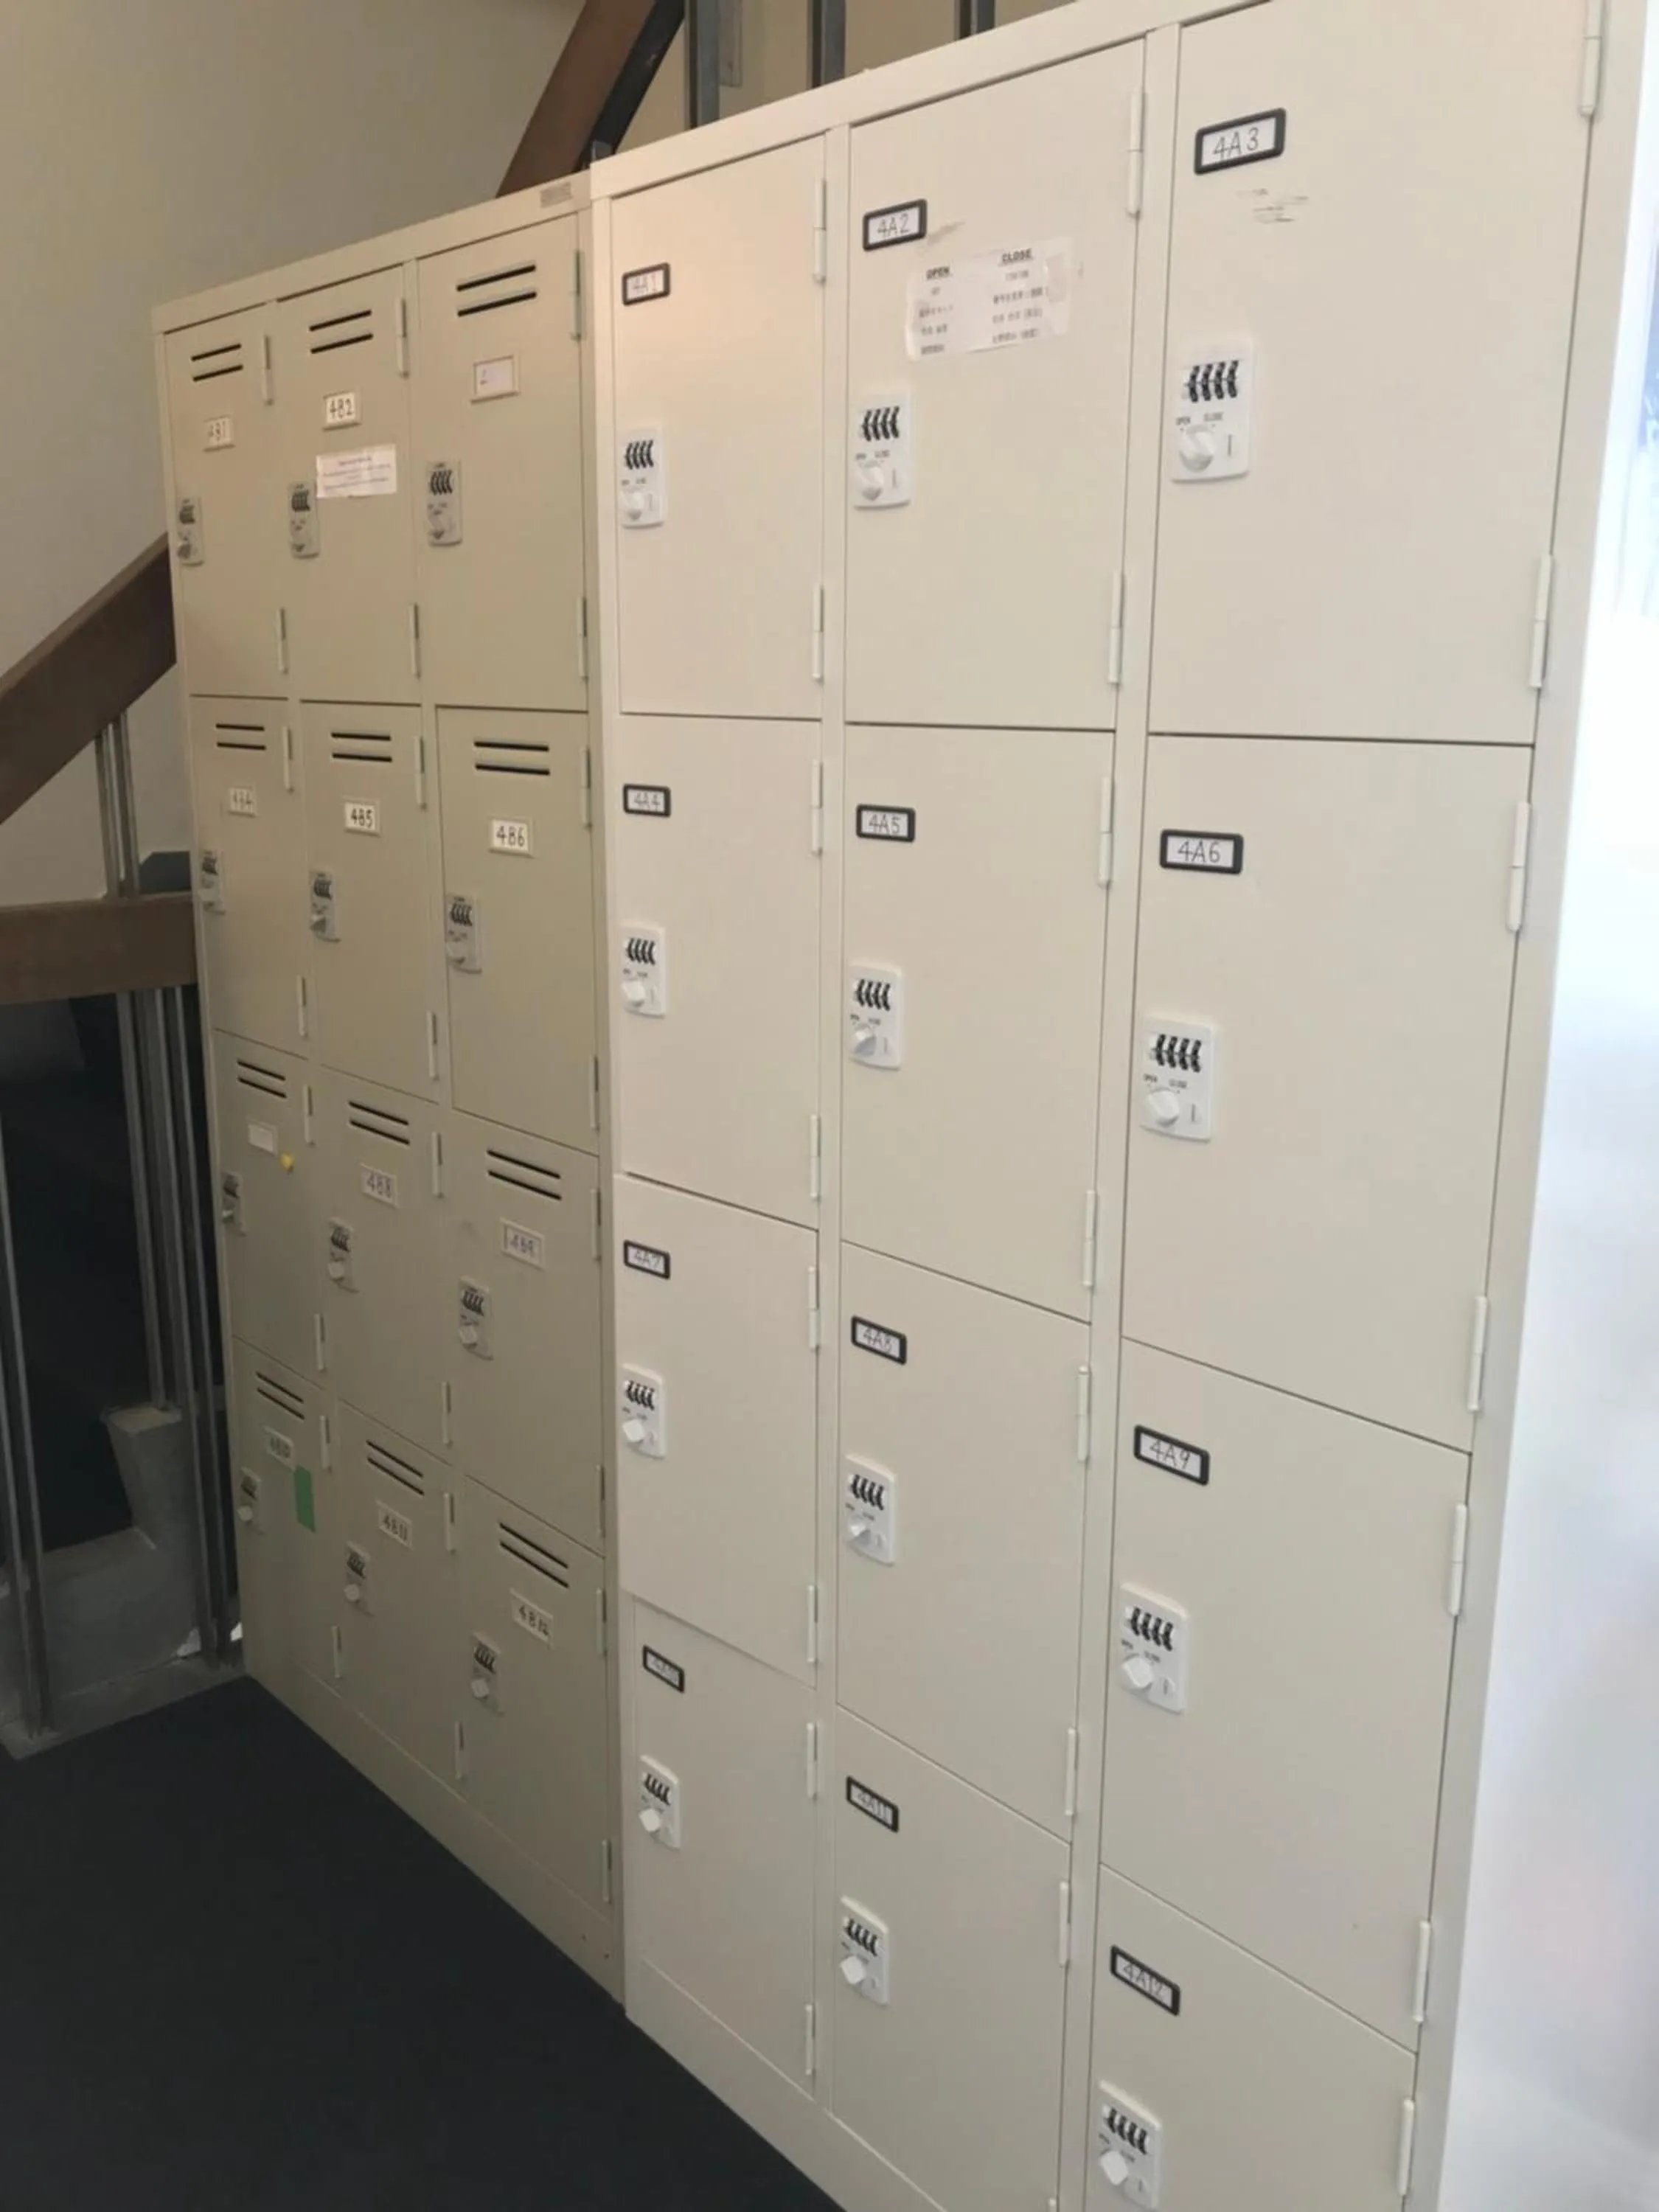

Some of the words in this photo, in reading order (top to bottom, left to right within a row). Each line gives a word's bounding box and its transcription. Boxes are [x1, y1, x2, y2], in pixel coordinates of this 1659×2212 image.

[1211, 126, 1259, 160] 4A3
[876, 212, 911, 238] 4A2
[1001, 247, 1033, 263] CLOSE
[926, 265, 950, 279] OPEN
[868, 812, 902, 836] 4A5
[1176, 839, 1221, 865] 4A6
